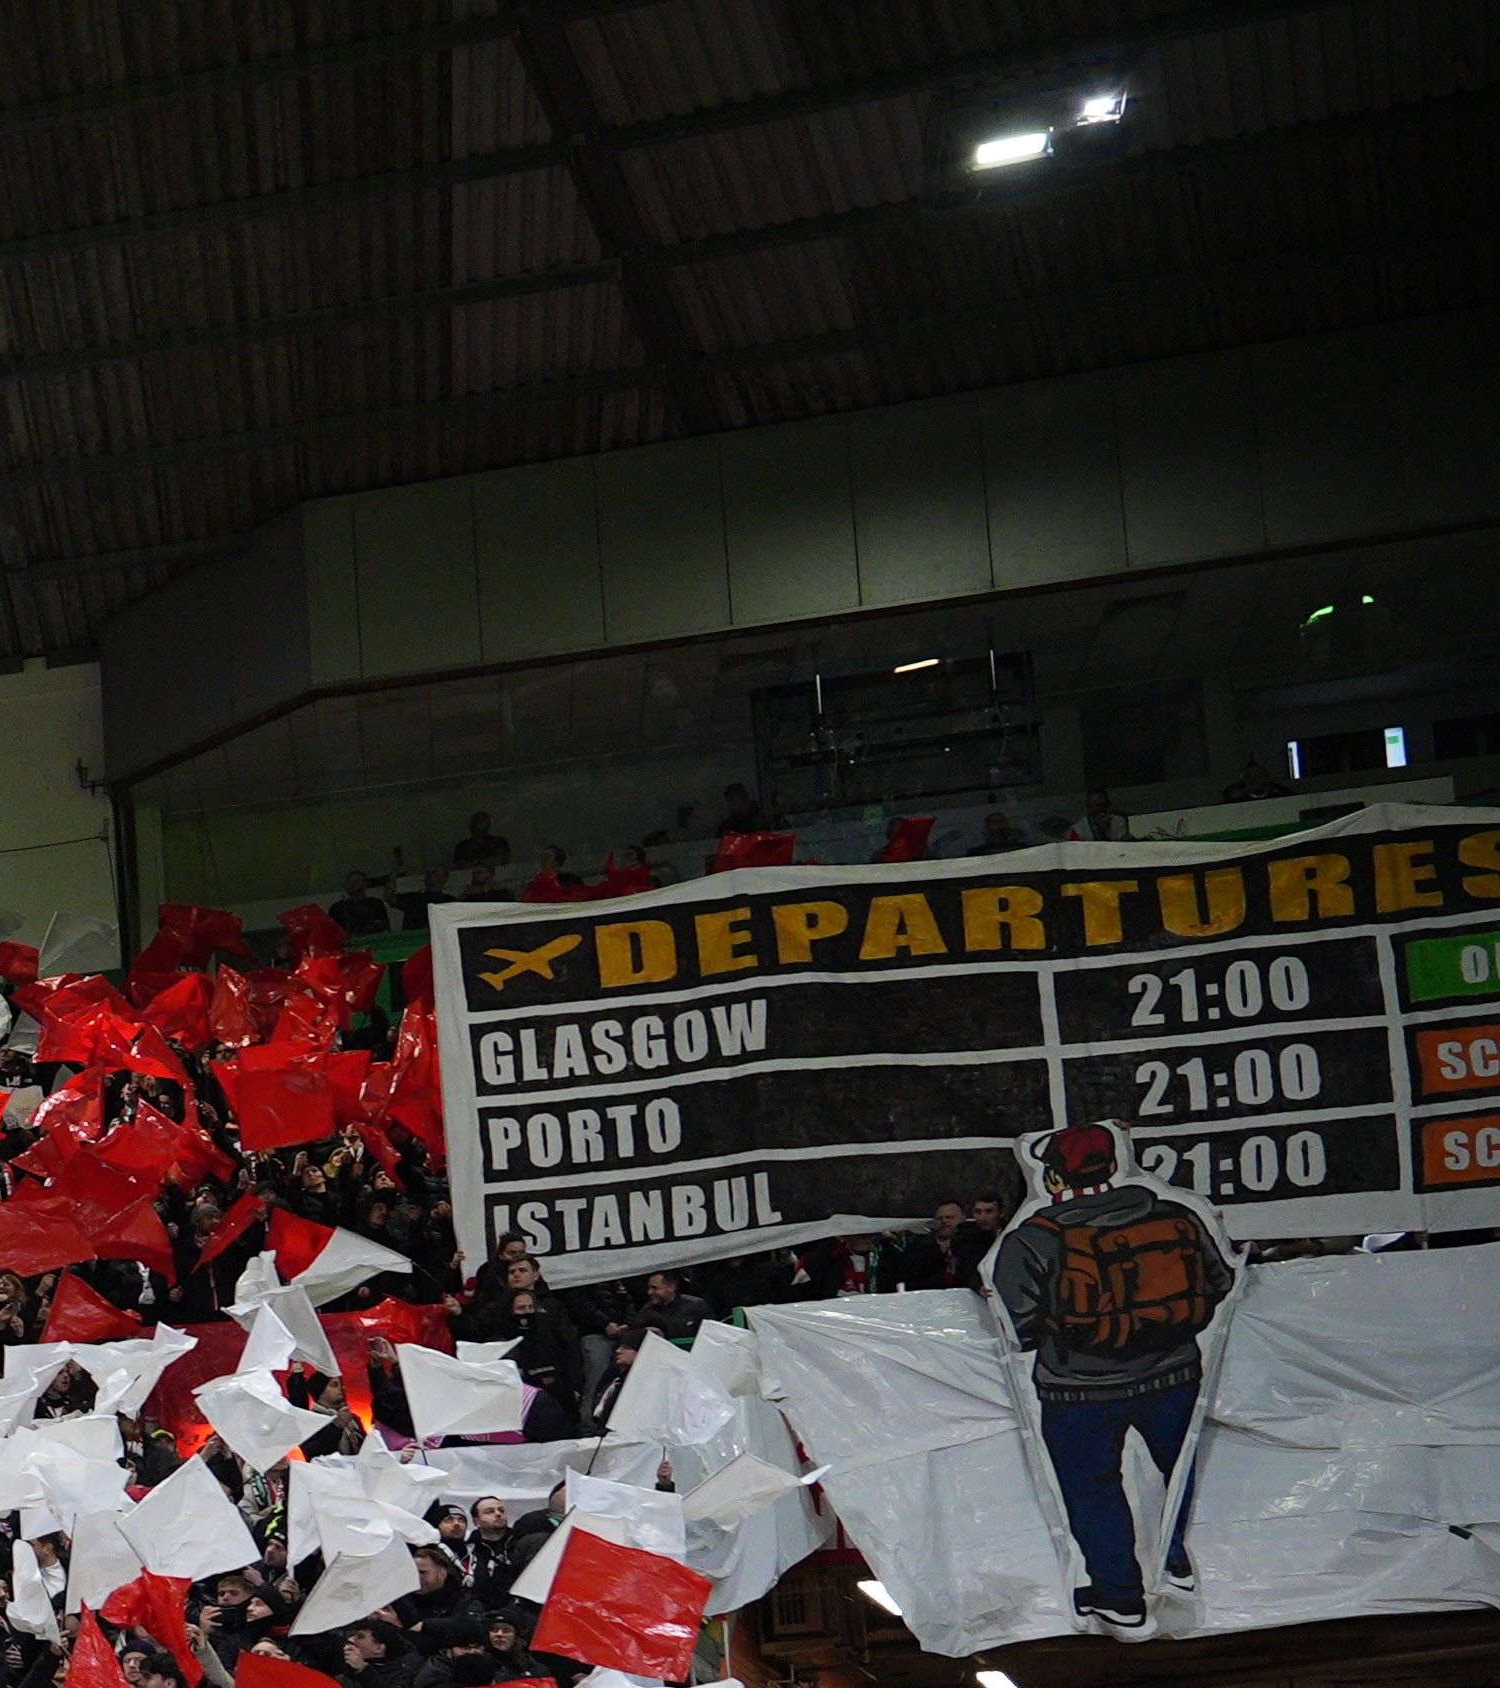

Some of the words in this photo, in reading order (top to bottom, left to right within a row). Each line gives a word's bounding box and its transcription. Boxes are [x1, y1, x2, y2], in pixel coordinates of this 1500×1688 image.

[478, 998, 768, 1086] GLASGOW
[1127, 956, 1310, 1027] 21:00
[1460, 943, 1500, 984] O
[488, 1097, 682, 1172] PORTO
[1135, 1043, 1322, 1117] 21:00
[492, 1171, 783, 1256] ISTANBUL
[1141, 1130, 1327, 1197] 21:00
